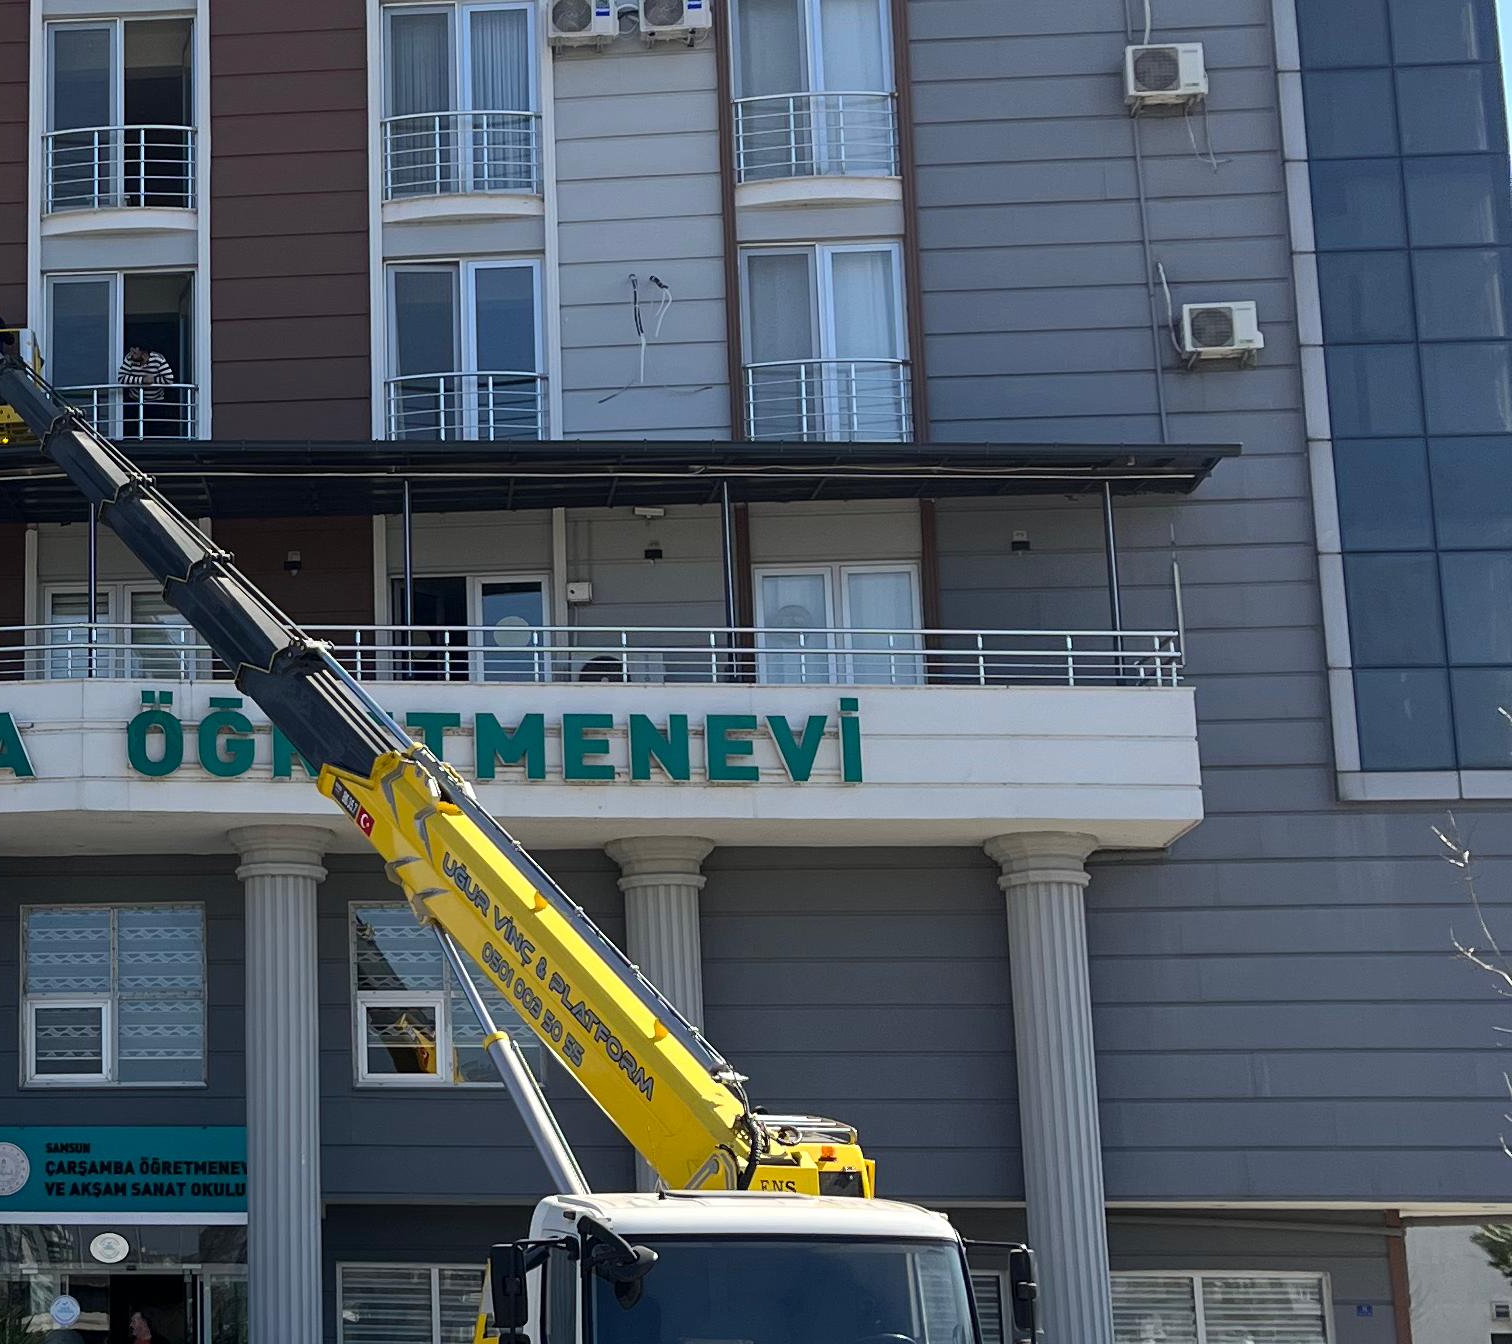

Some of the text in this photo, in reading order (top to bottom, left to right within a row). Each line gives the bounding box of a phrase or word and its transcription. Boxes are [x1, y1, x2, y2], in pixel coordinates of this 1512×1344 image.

[126, 690, 864, 784] ÖĞTMENEVİ
[442, 852, 654, 1101] UĞUR VİNÇ & PLATFORM
[482, 942, 585, 1068] 0501 003 50 55
[45, 1160, 136, 1177] ÇARŞAMBA
[46, 1142, 91, 1153] SAMSUN
[45, 1182, 247, 1198] VE AKŞAM SANAT OKULU
